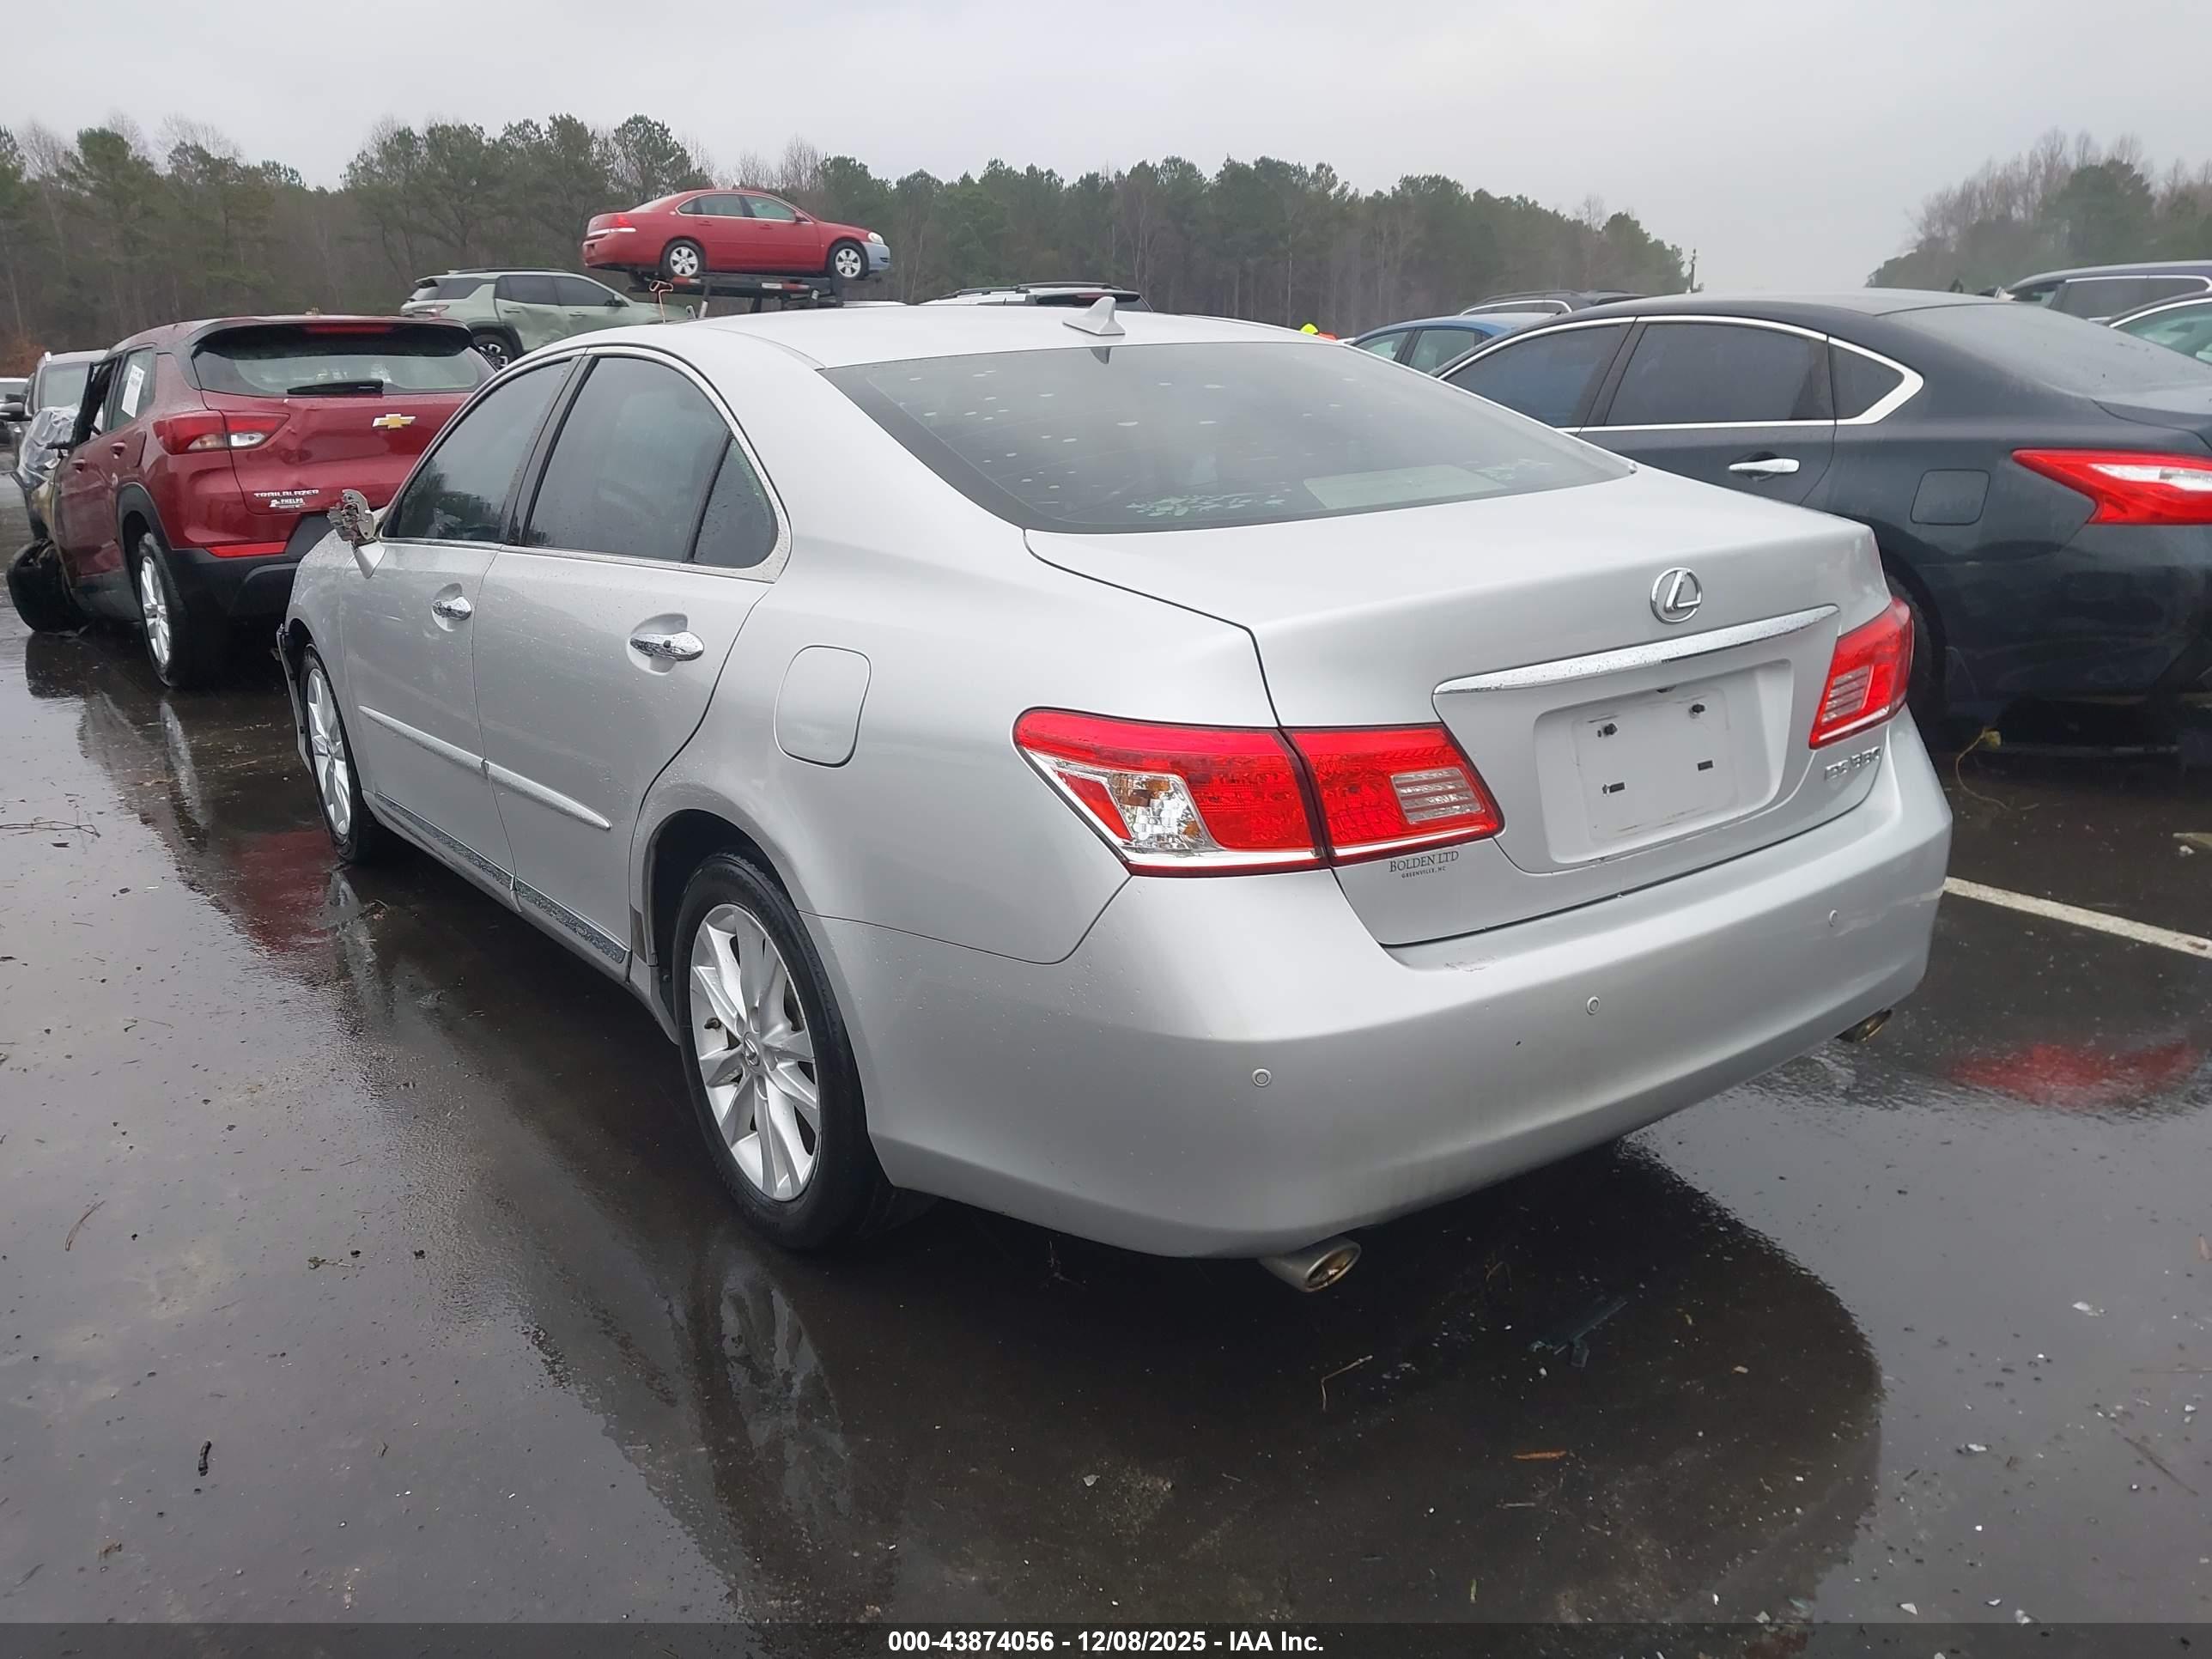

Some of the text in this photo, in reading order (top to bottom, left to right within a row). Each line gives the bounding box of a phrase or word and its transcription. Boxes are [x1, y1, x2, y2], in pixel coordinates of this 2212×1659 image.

[253, 489, 319, 498] TRAILBLAZER
[1389, 851, 1460, 872] BOLDEN LTD
